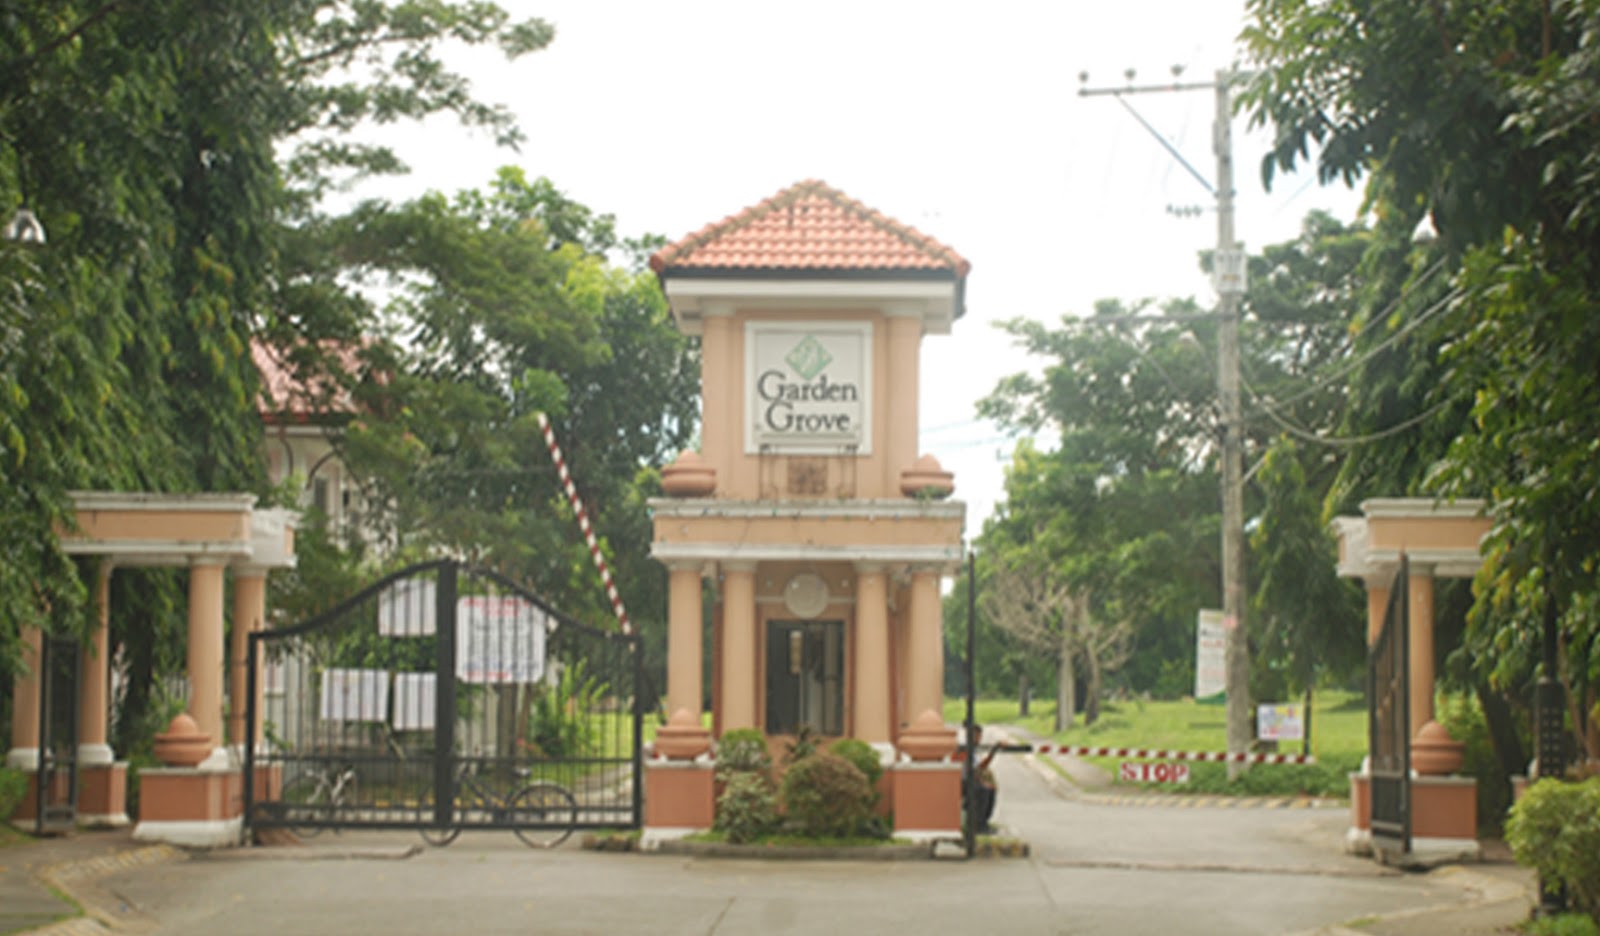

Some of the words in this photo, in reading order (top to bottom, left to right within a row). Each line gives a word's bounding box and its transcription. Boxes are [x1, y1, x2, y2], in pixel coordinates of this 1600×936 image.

[757, 370, 857, 401] Garden
[765, 401, 850, 431] Grove
[1121, 762, 1187, 782] STOP
